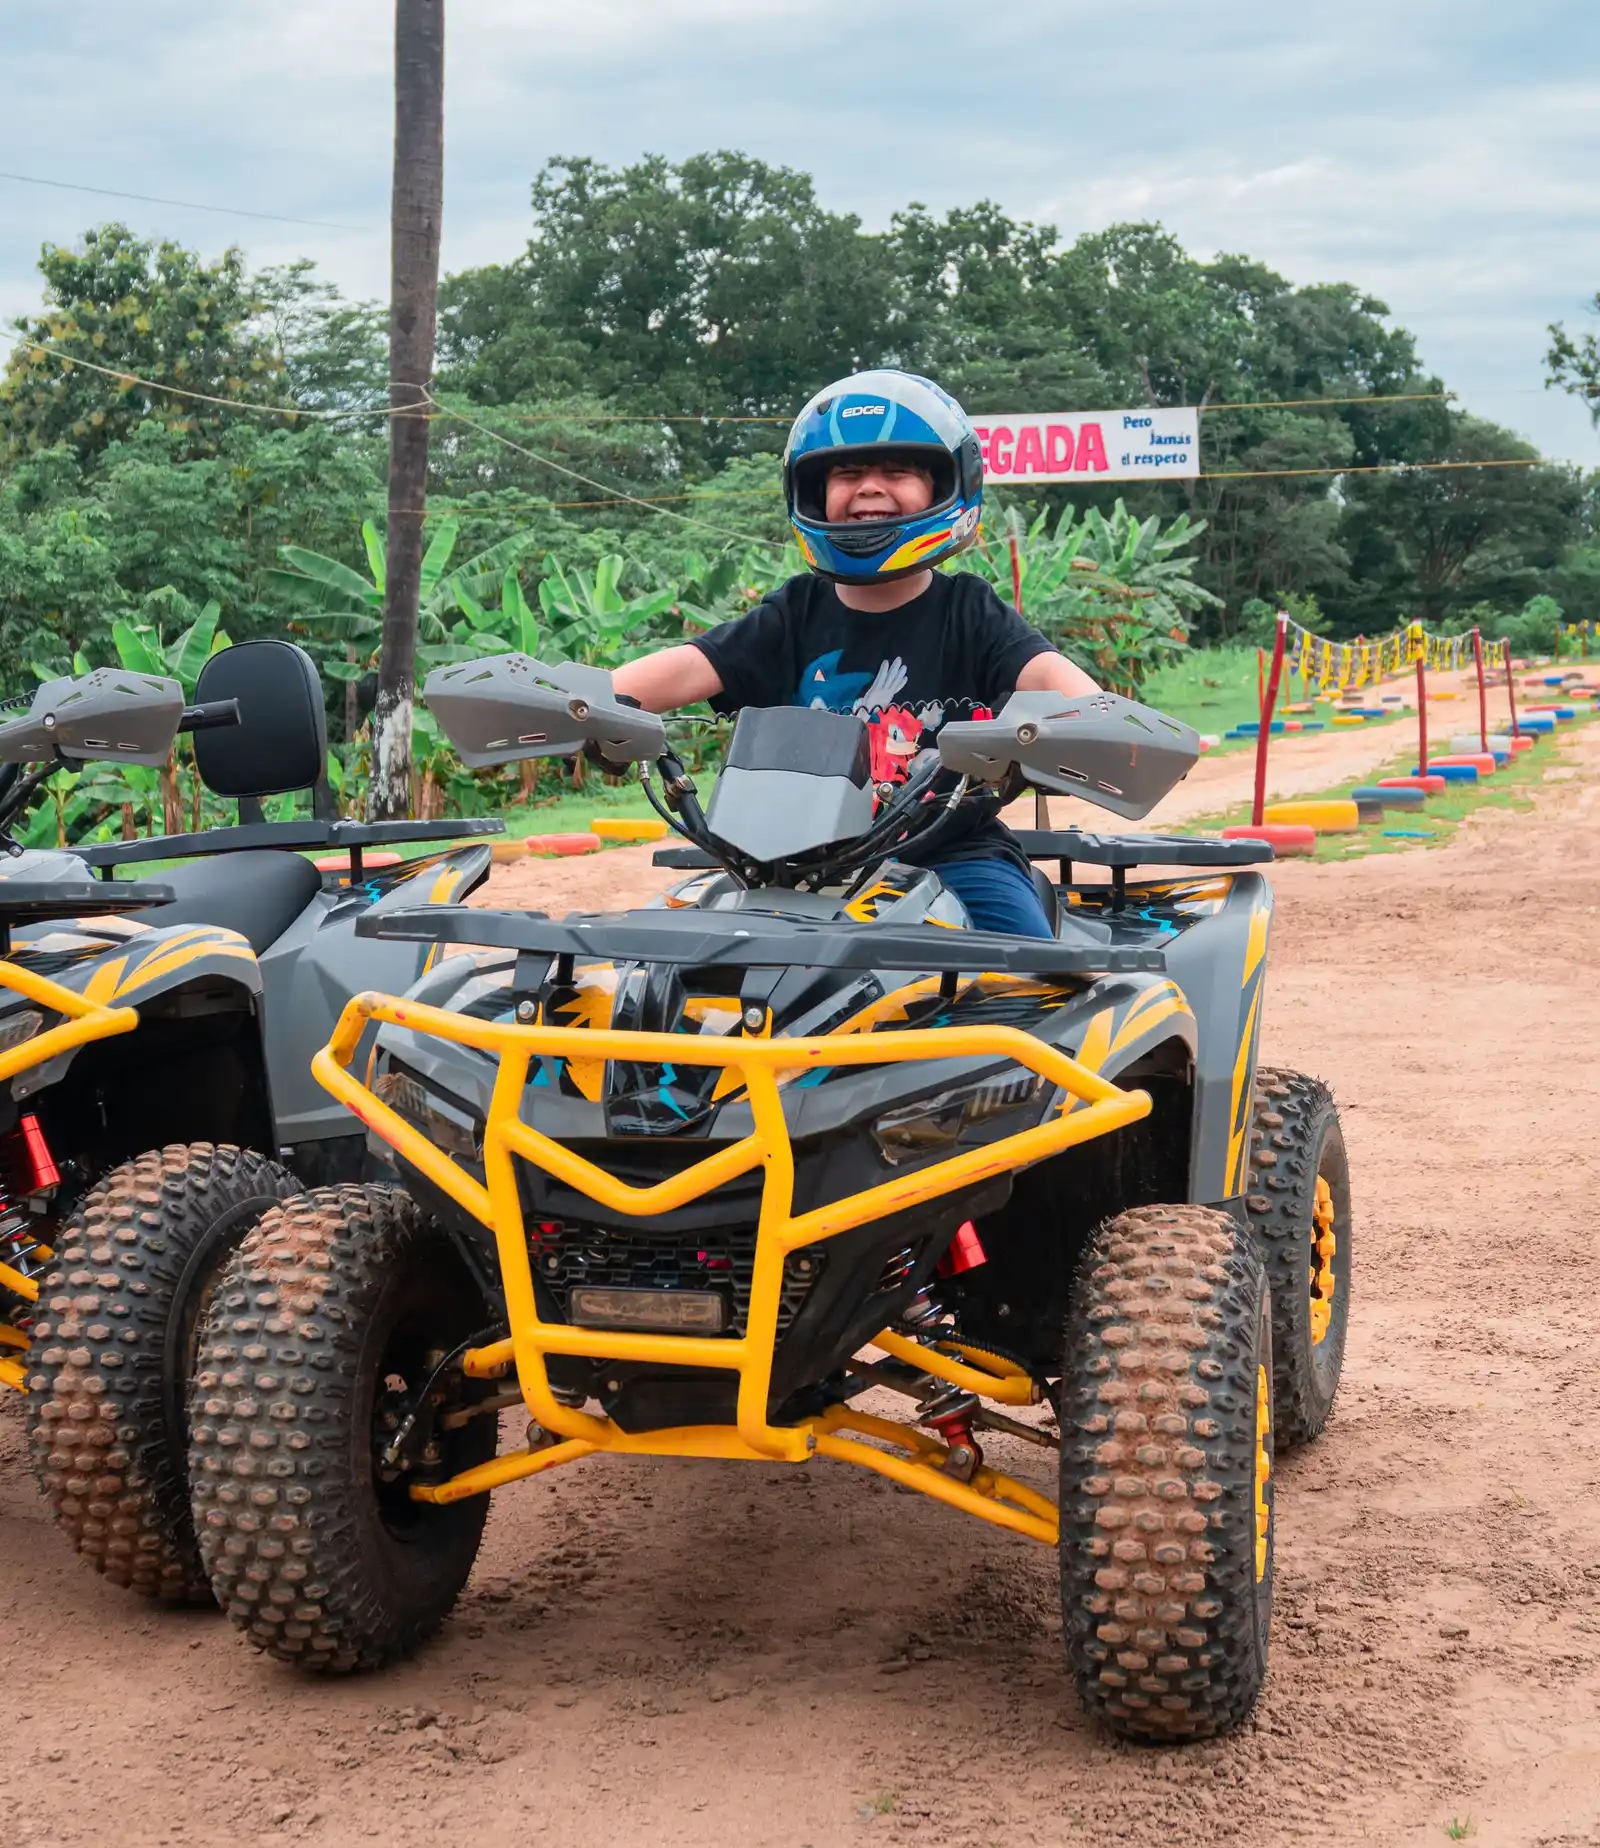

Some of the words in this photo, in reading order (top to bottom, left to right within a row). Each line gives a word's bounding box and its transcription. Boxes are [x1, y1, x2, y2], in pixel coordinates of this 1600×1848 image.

[842, 405, 886, 418] EDGE
[1123, 415, 1152, 429] Pero
[1121, 452, 1130, 465] el
[1134, 452, 1187, 467] respeto
